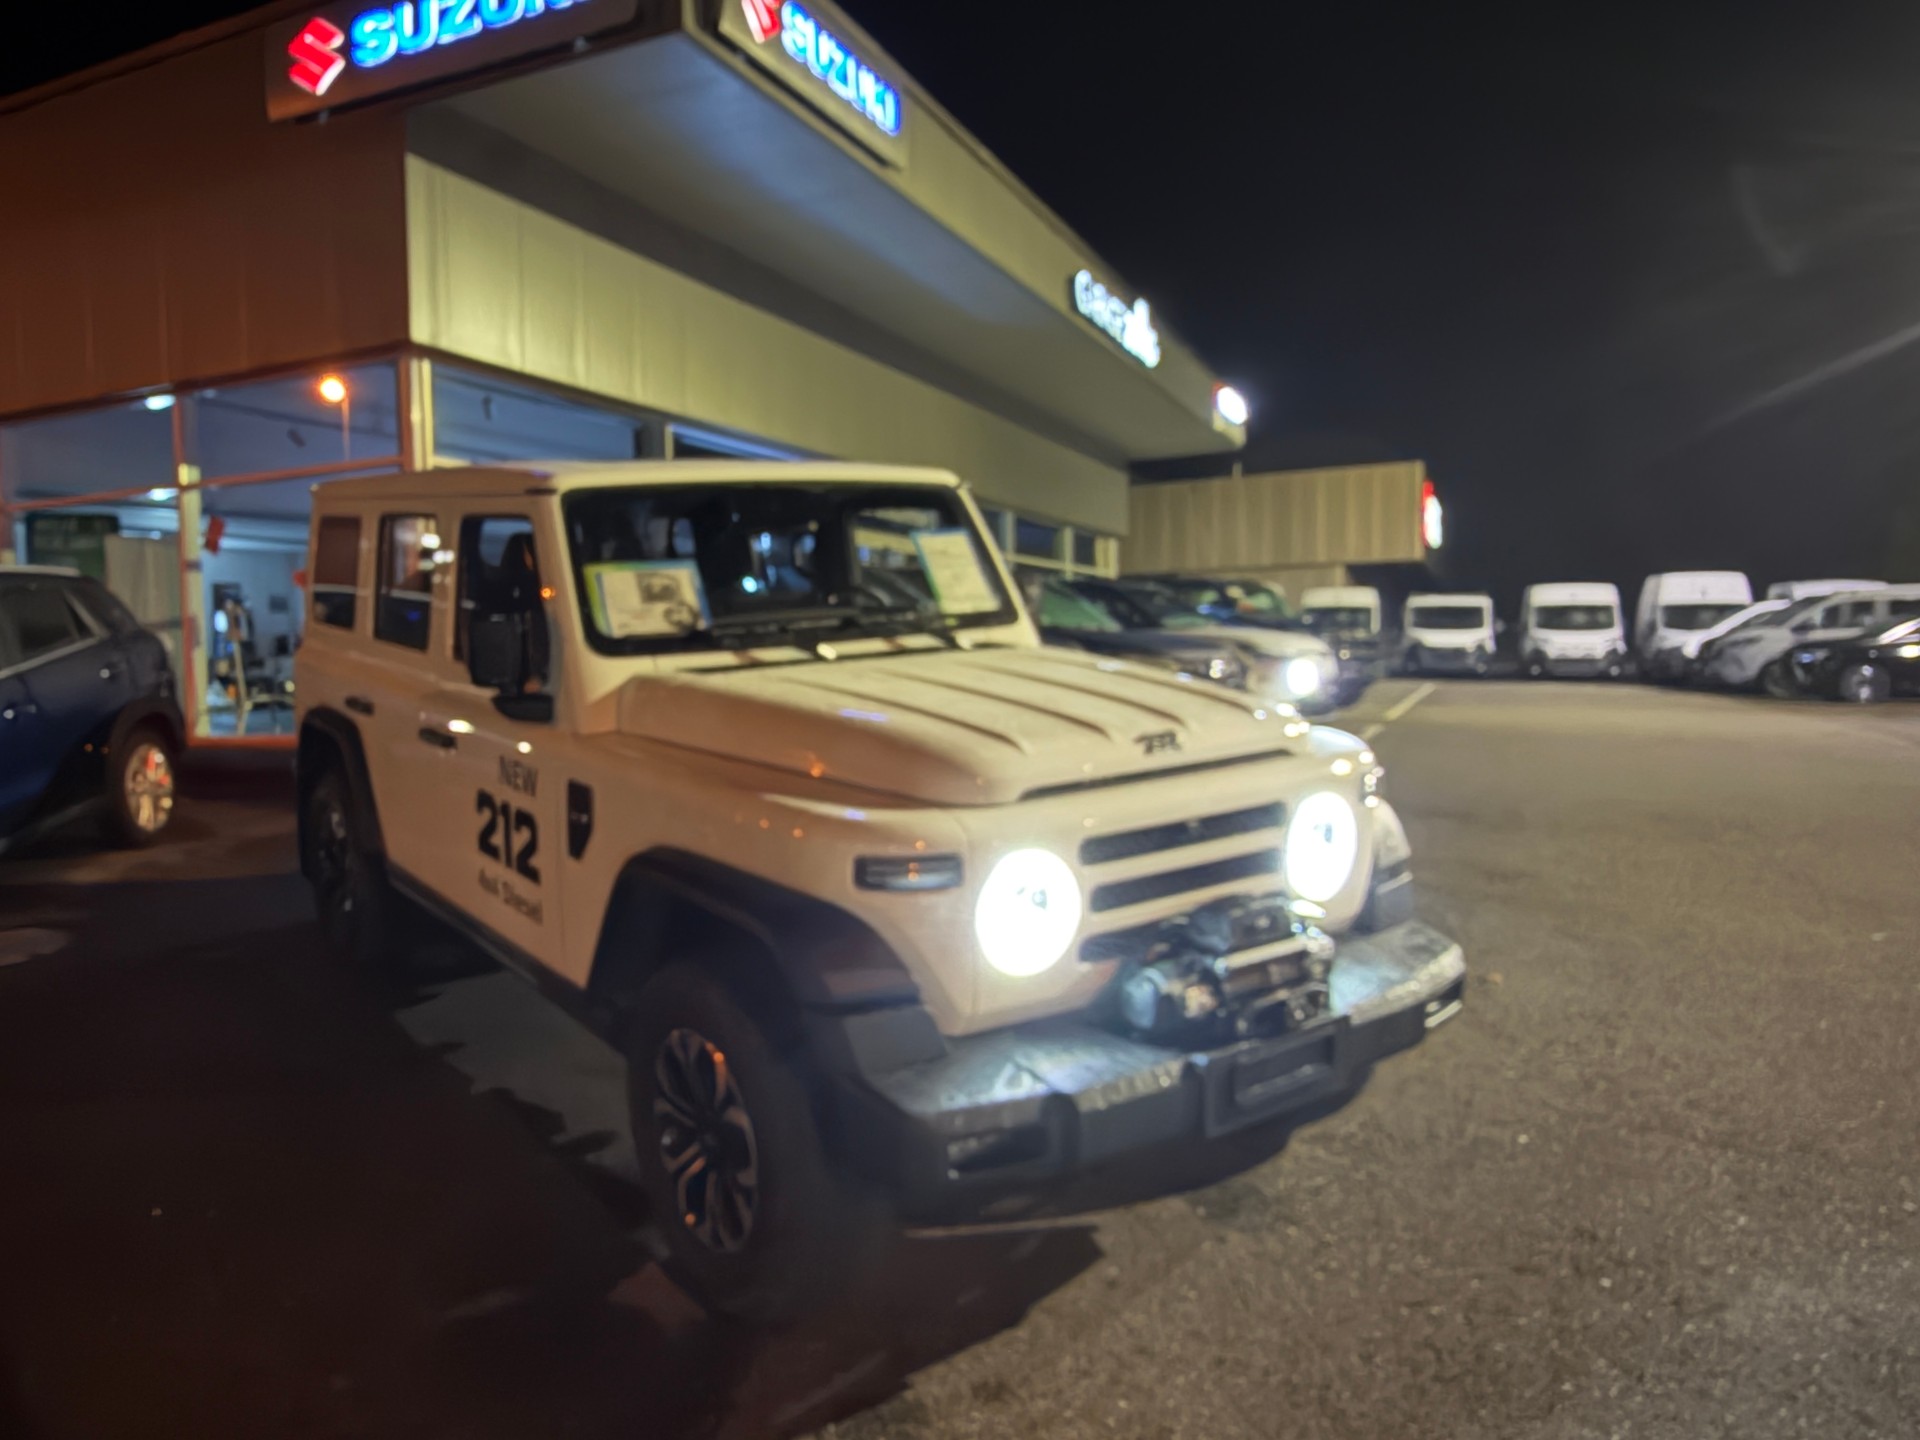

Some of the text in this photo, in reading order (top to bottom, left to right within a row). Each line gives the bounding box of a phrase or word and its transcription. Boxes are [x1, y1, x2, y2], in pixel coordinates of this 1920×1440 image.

[348, 0, 592, 67] SUZU
[499, 757, 539, 796] NEW
[477, 789, 541, 884] 212
